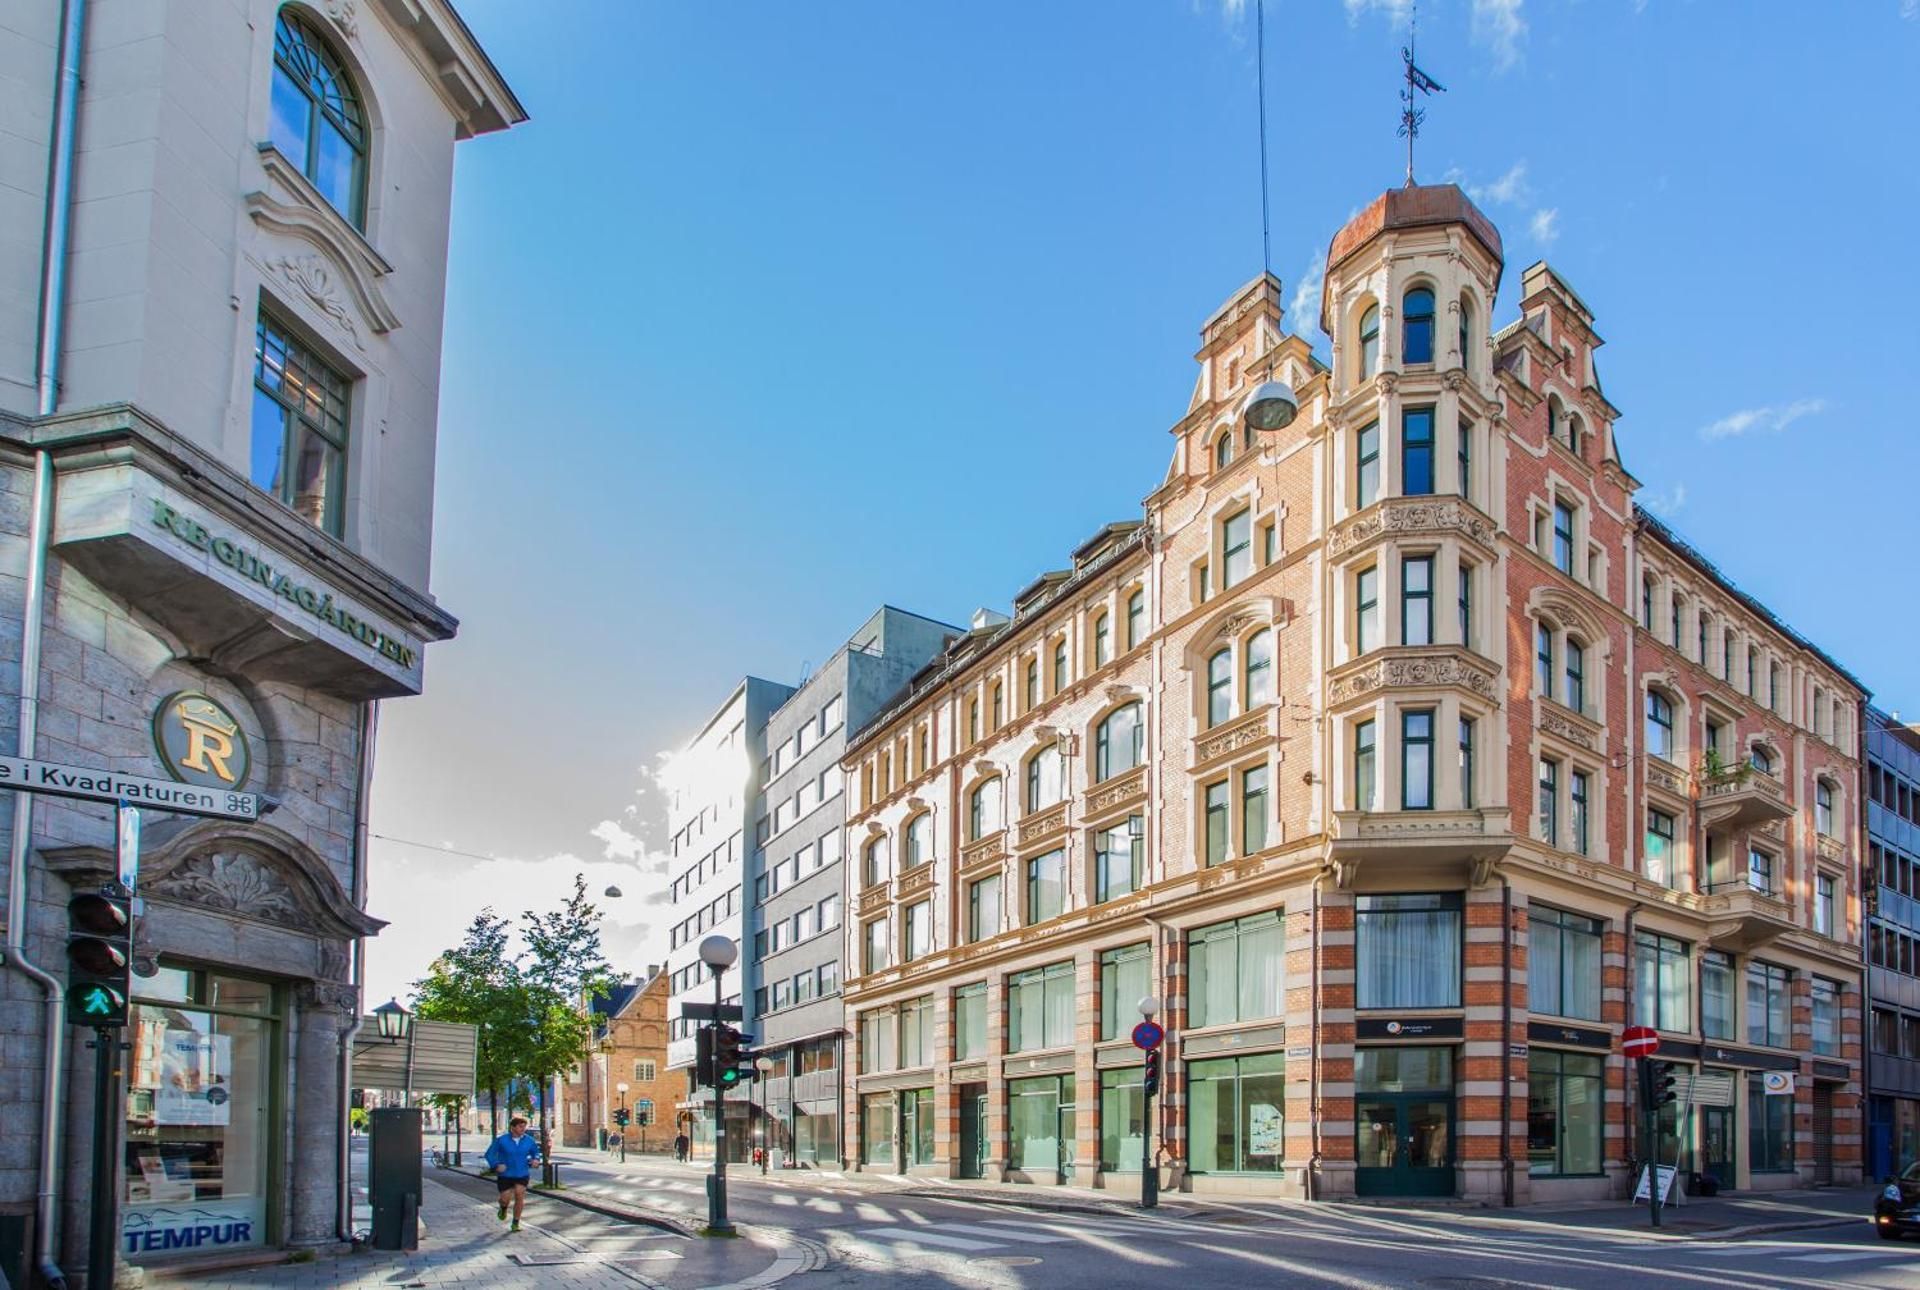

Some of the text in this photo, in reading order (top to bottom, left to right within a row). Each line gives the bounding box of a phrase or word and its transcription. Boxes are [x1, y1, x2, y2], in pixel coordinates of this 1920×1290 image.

[152, 498, 418, 670] REGINAGÅRDEN
[180, 722, 236, 782] R
[24, 764, 29, 781] i
[41, 766, 214, 808] Kvadraturen
[124, 1222, 251, 1253] TEMPUR
